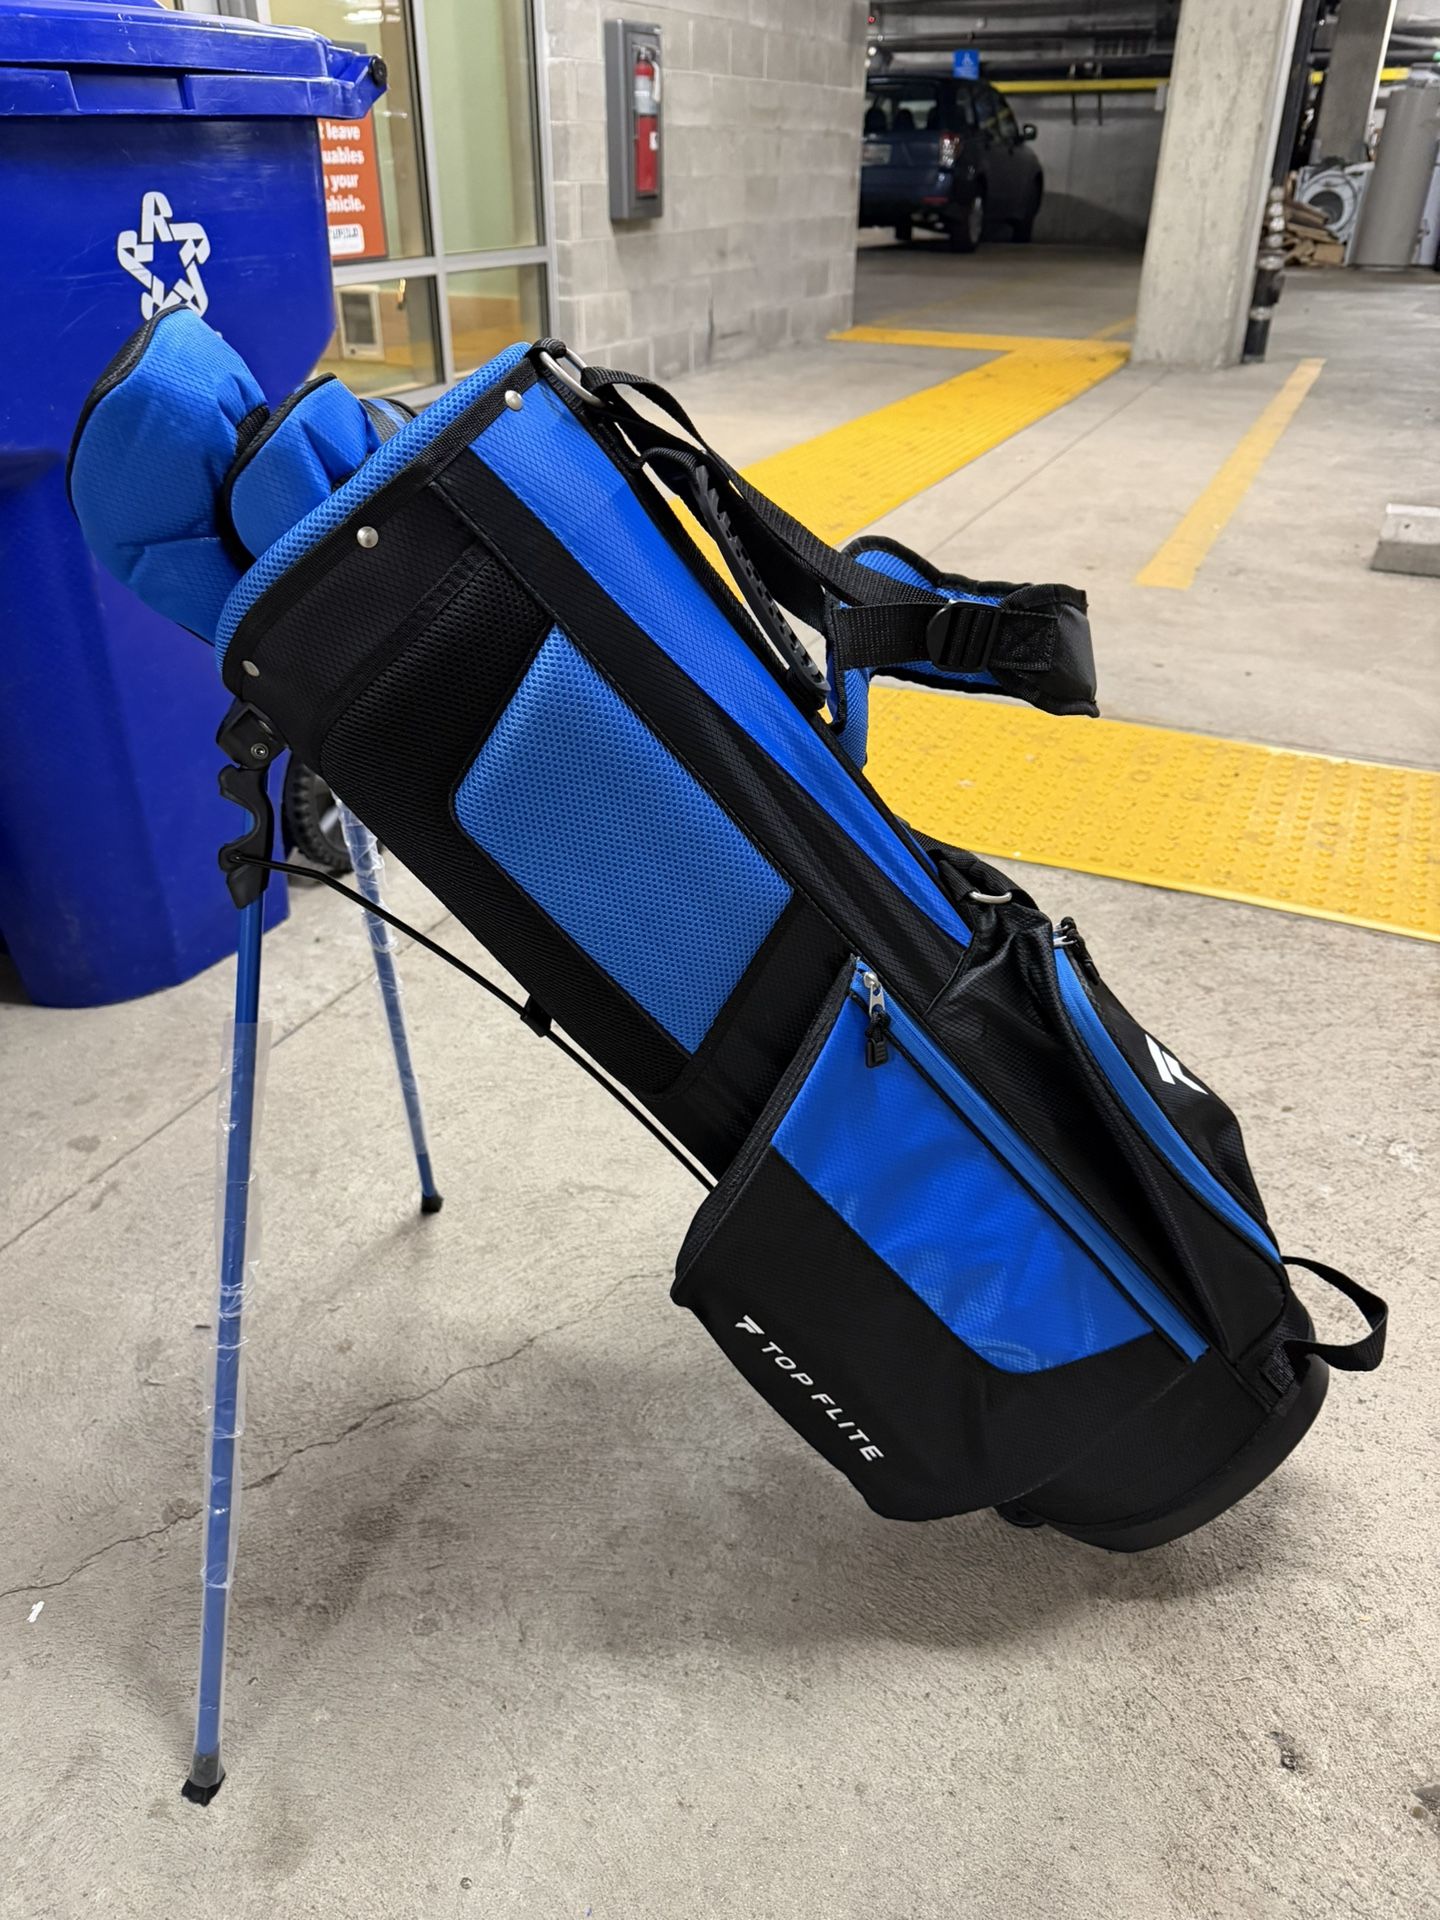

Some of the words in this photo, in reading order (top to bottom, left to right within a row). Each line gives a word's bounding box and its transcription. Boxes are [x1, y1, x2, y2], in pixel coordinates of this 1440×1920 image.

[325, 121, 361, 141] leave
[322, 146, 365, 165] uables
[330, 174, 359, 193] your
[326, 194, 365, 213] ehicle.
[762, 1341, 813, 1386] TOP
[811, 1393, 885, 1461] FLITE
